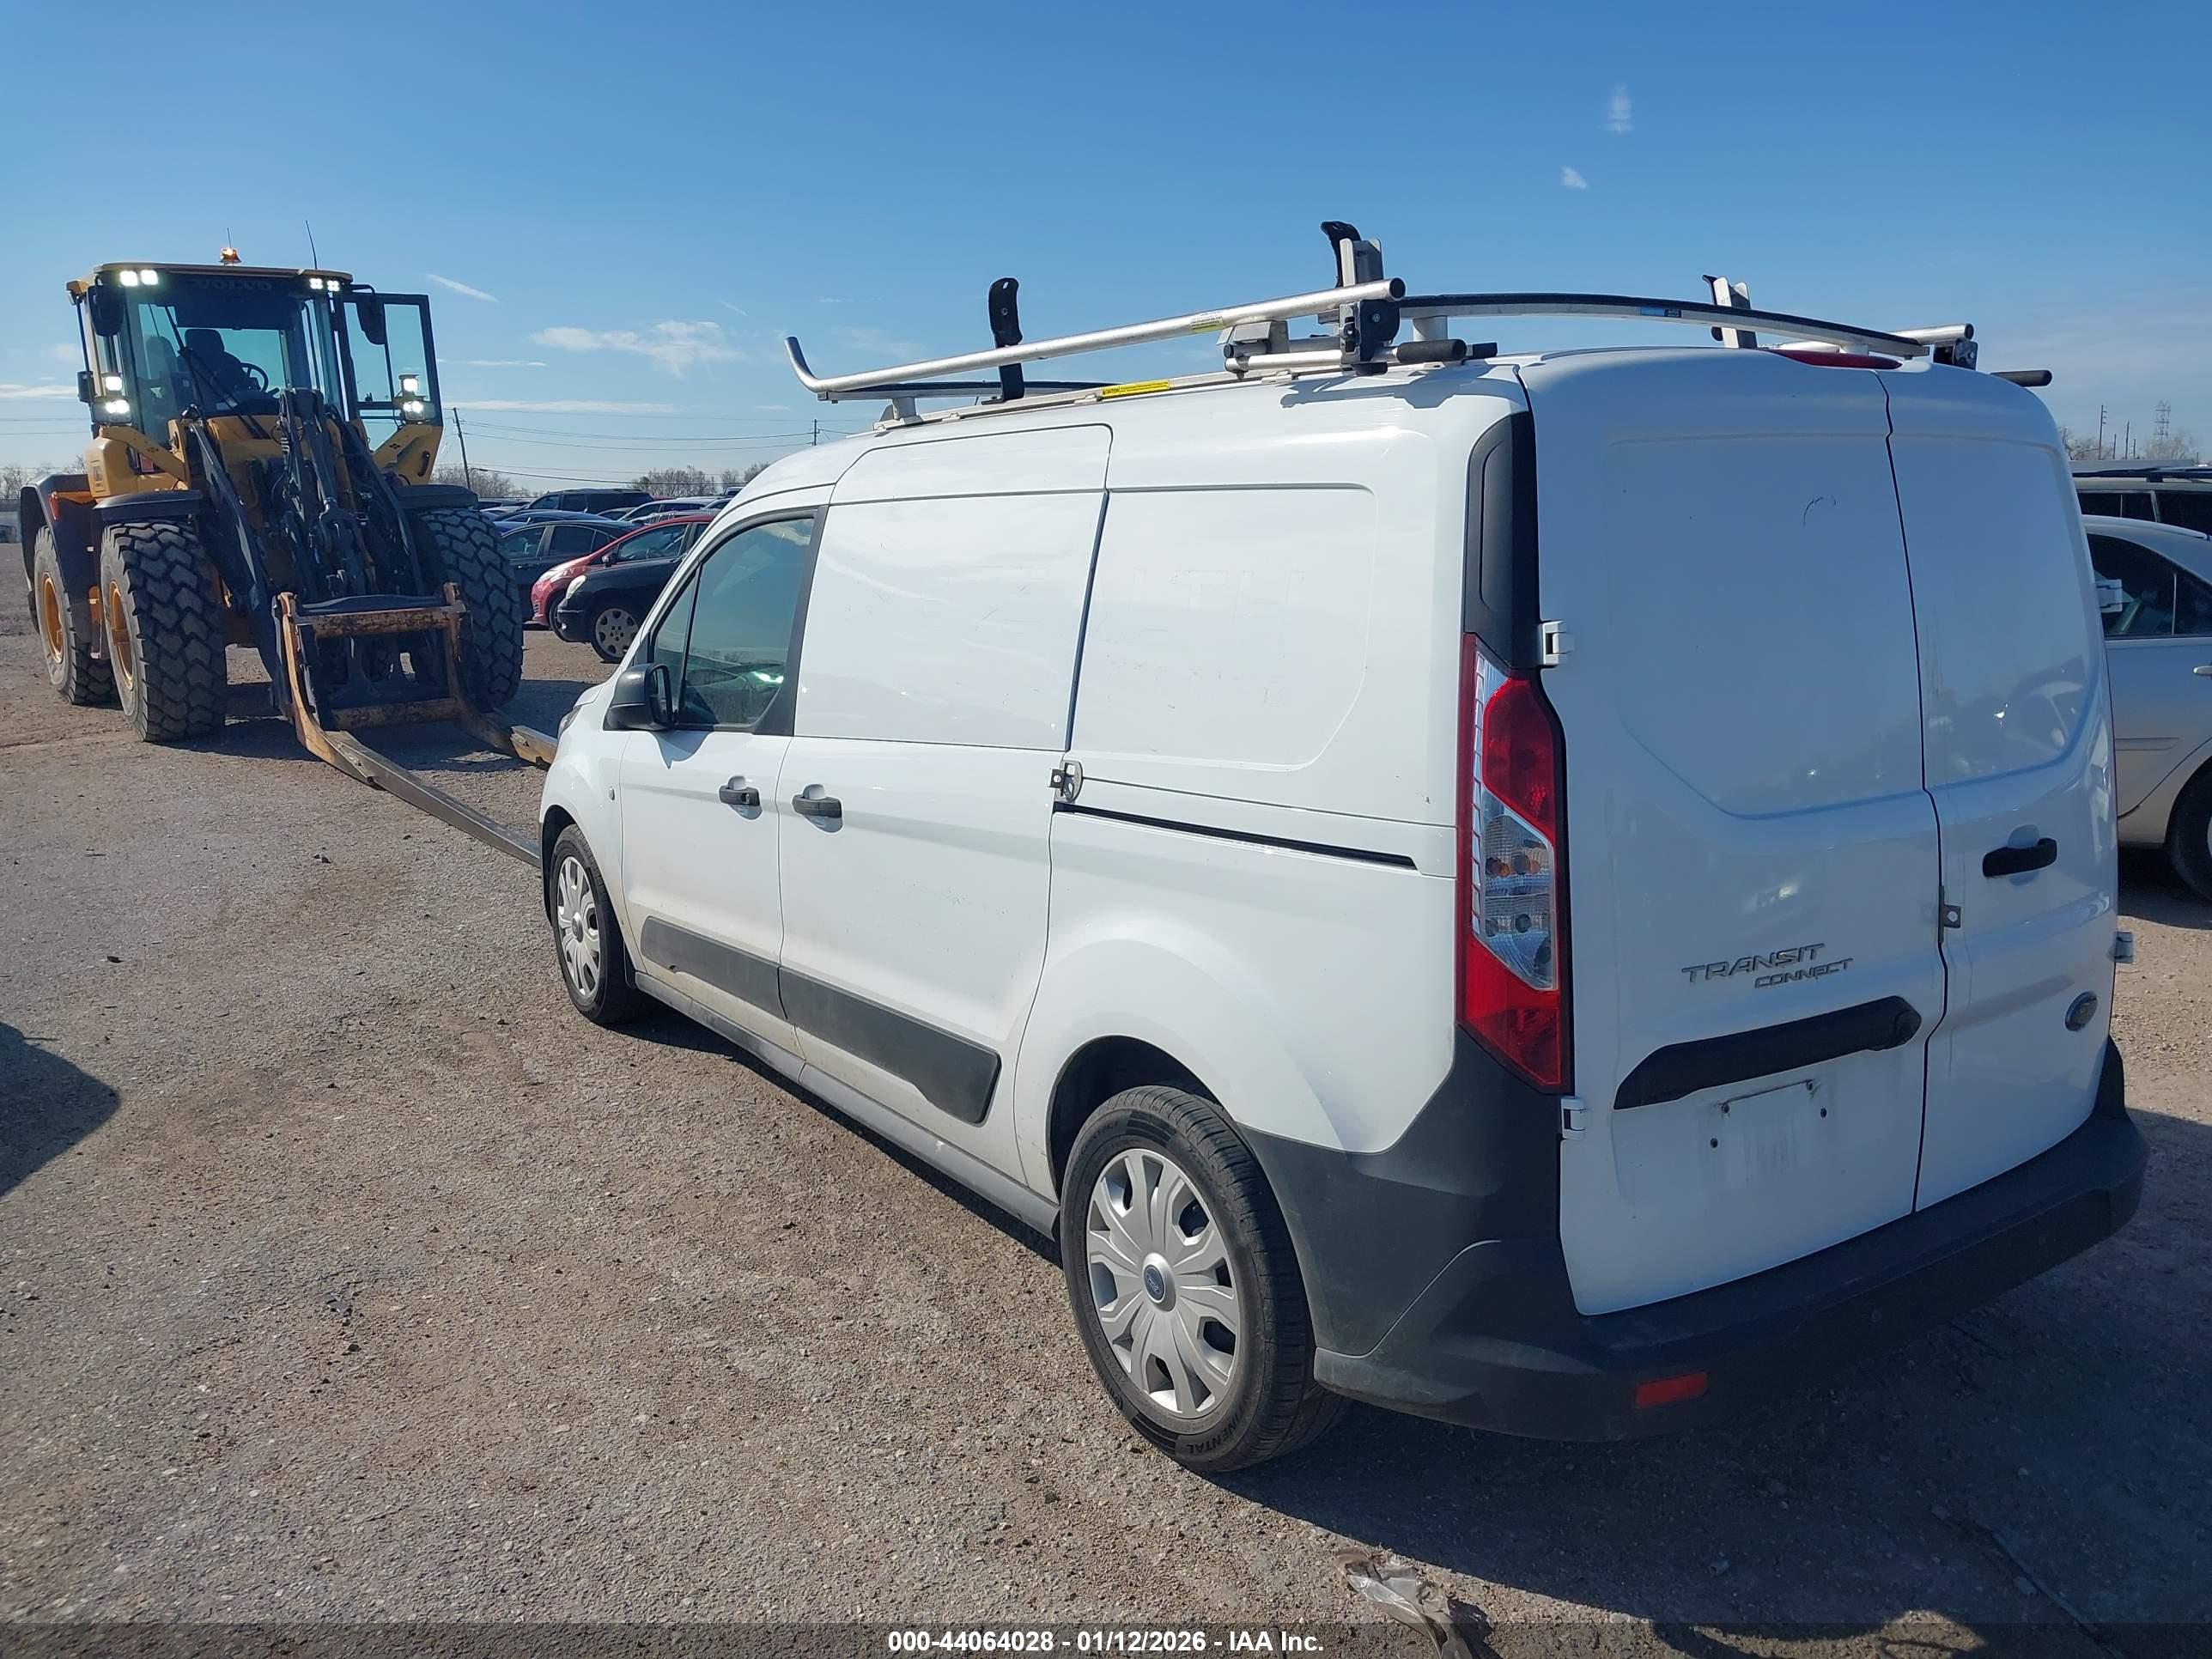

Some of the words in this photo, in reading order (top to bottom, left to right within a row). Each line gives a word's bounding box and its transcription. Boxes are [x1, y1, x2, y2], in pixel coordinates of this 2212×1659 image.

[194, 279, 272, 290] VOLVO
[1681, 943, 1825, 983] TRANSIT
[1754, 957, 1854, 988] CONNECT
